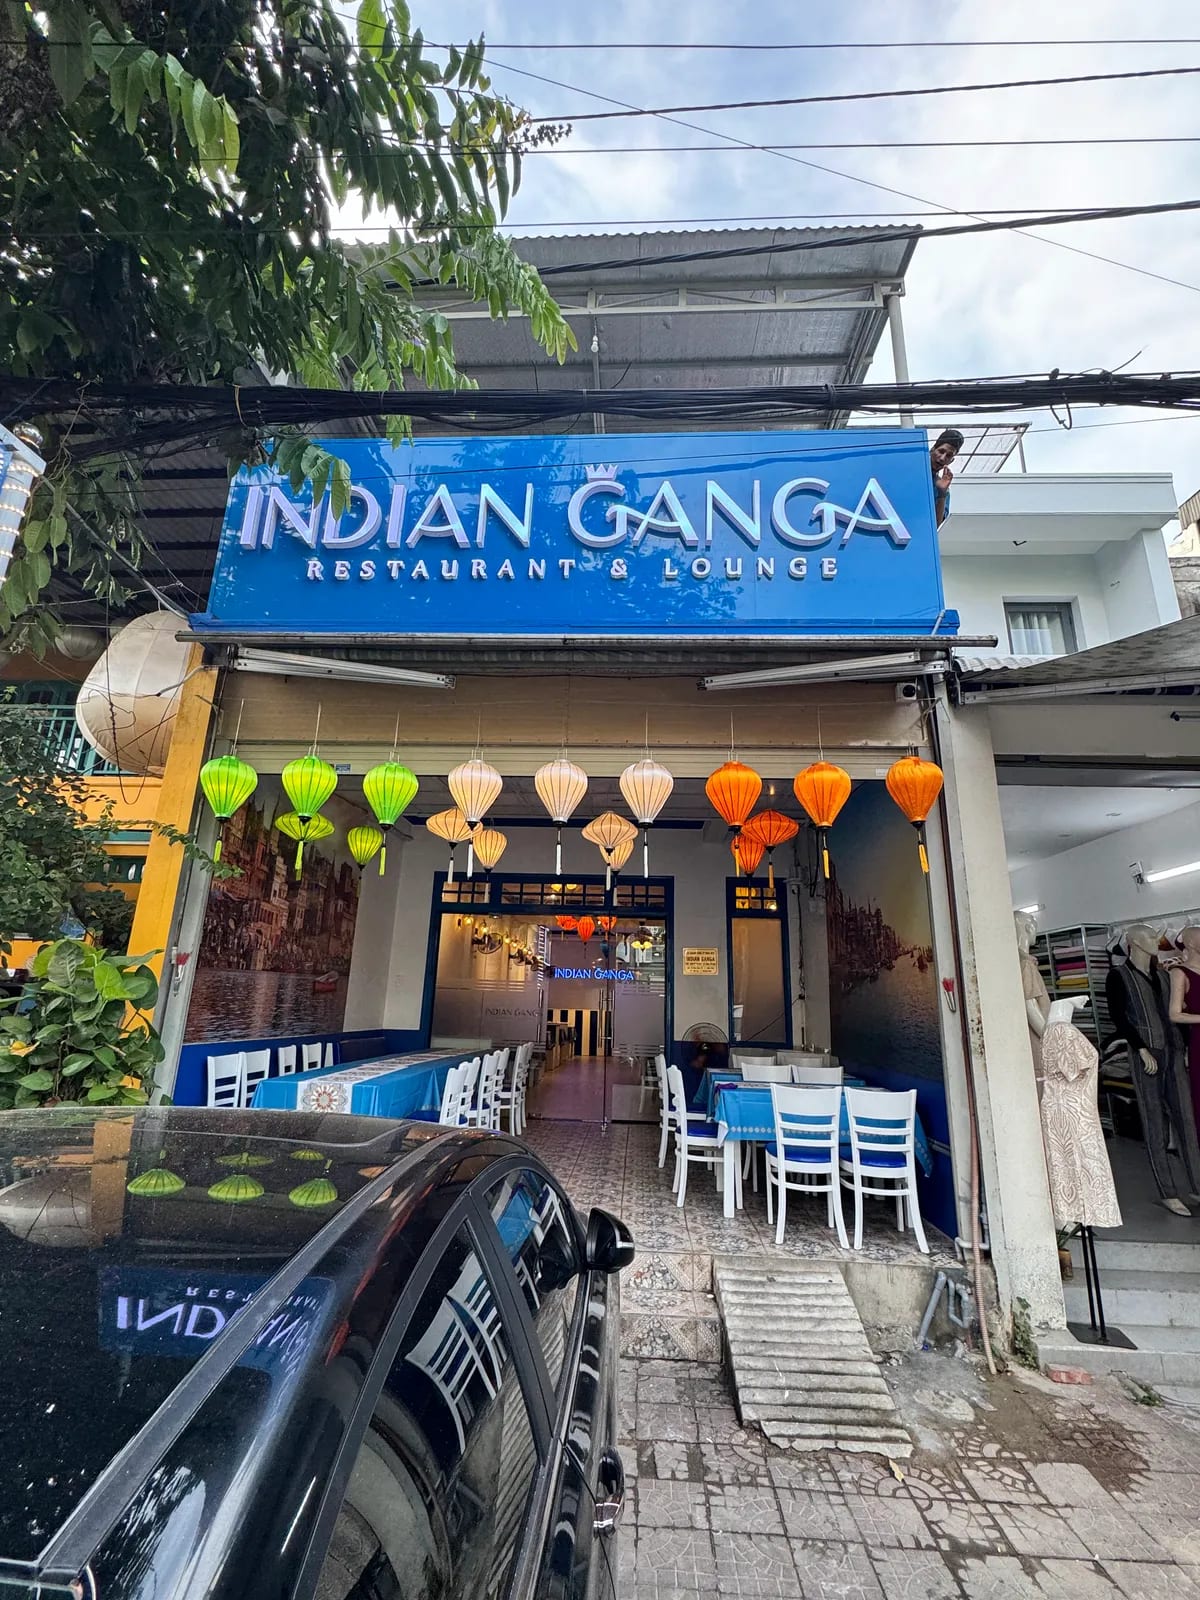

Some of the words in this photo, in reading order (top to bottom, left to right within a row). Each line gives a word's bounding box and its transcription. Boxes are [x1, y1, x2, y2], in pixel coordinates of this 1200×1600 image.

[240, 483, 534, 550] INDIAN
[567, 477, 912, 548] GANGA
[306, 558, 576, 581] RESTAURANT
[610, 557, 628, 579] &
[664, 557, 839, 580] LOUNGE
[554, 967, 591, 979] INDIAN
[594, 968, 634, 981] GANGA
